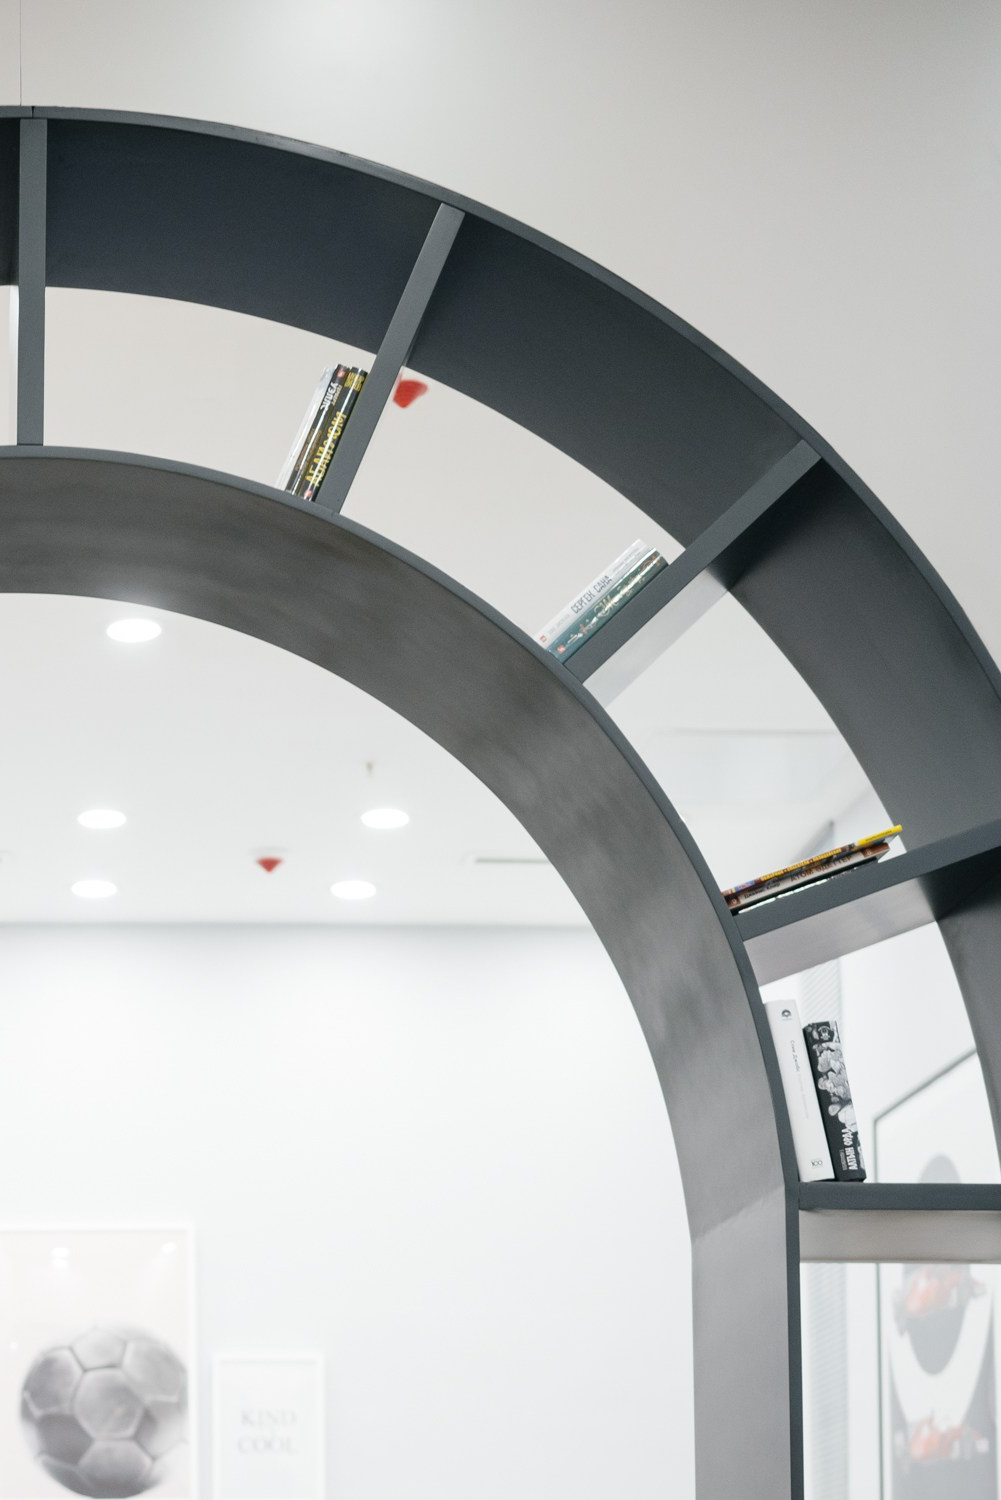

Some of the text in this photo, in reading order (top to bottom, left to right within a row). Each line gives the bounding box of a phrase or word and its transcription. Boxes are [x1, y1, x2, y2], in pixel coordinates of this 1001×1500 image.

[844, 1145, 859, 1171] АЛТЫН
[240, 1407, 297, 1426] KIND
[237, 1434, 300, 1456] COOL
